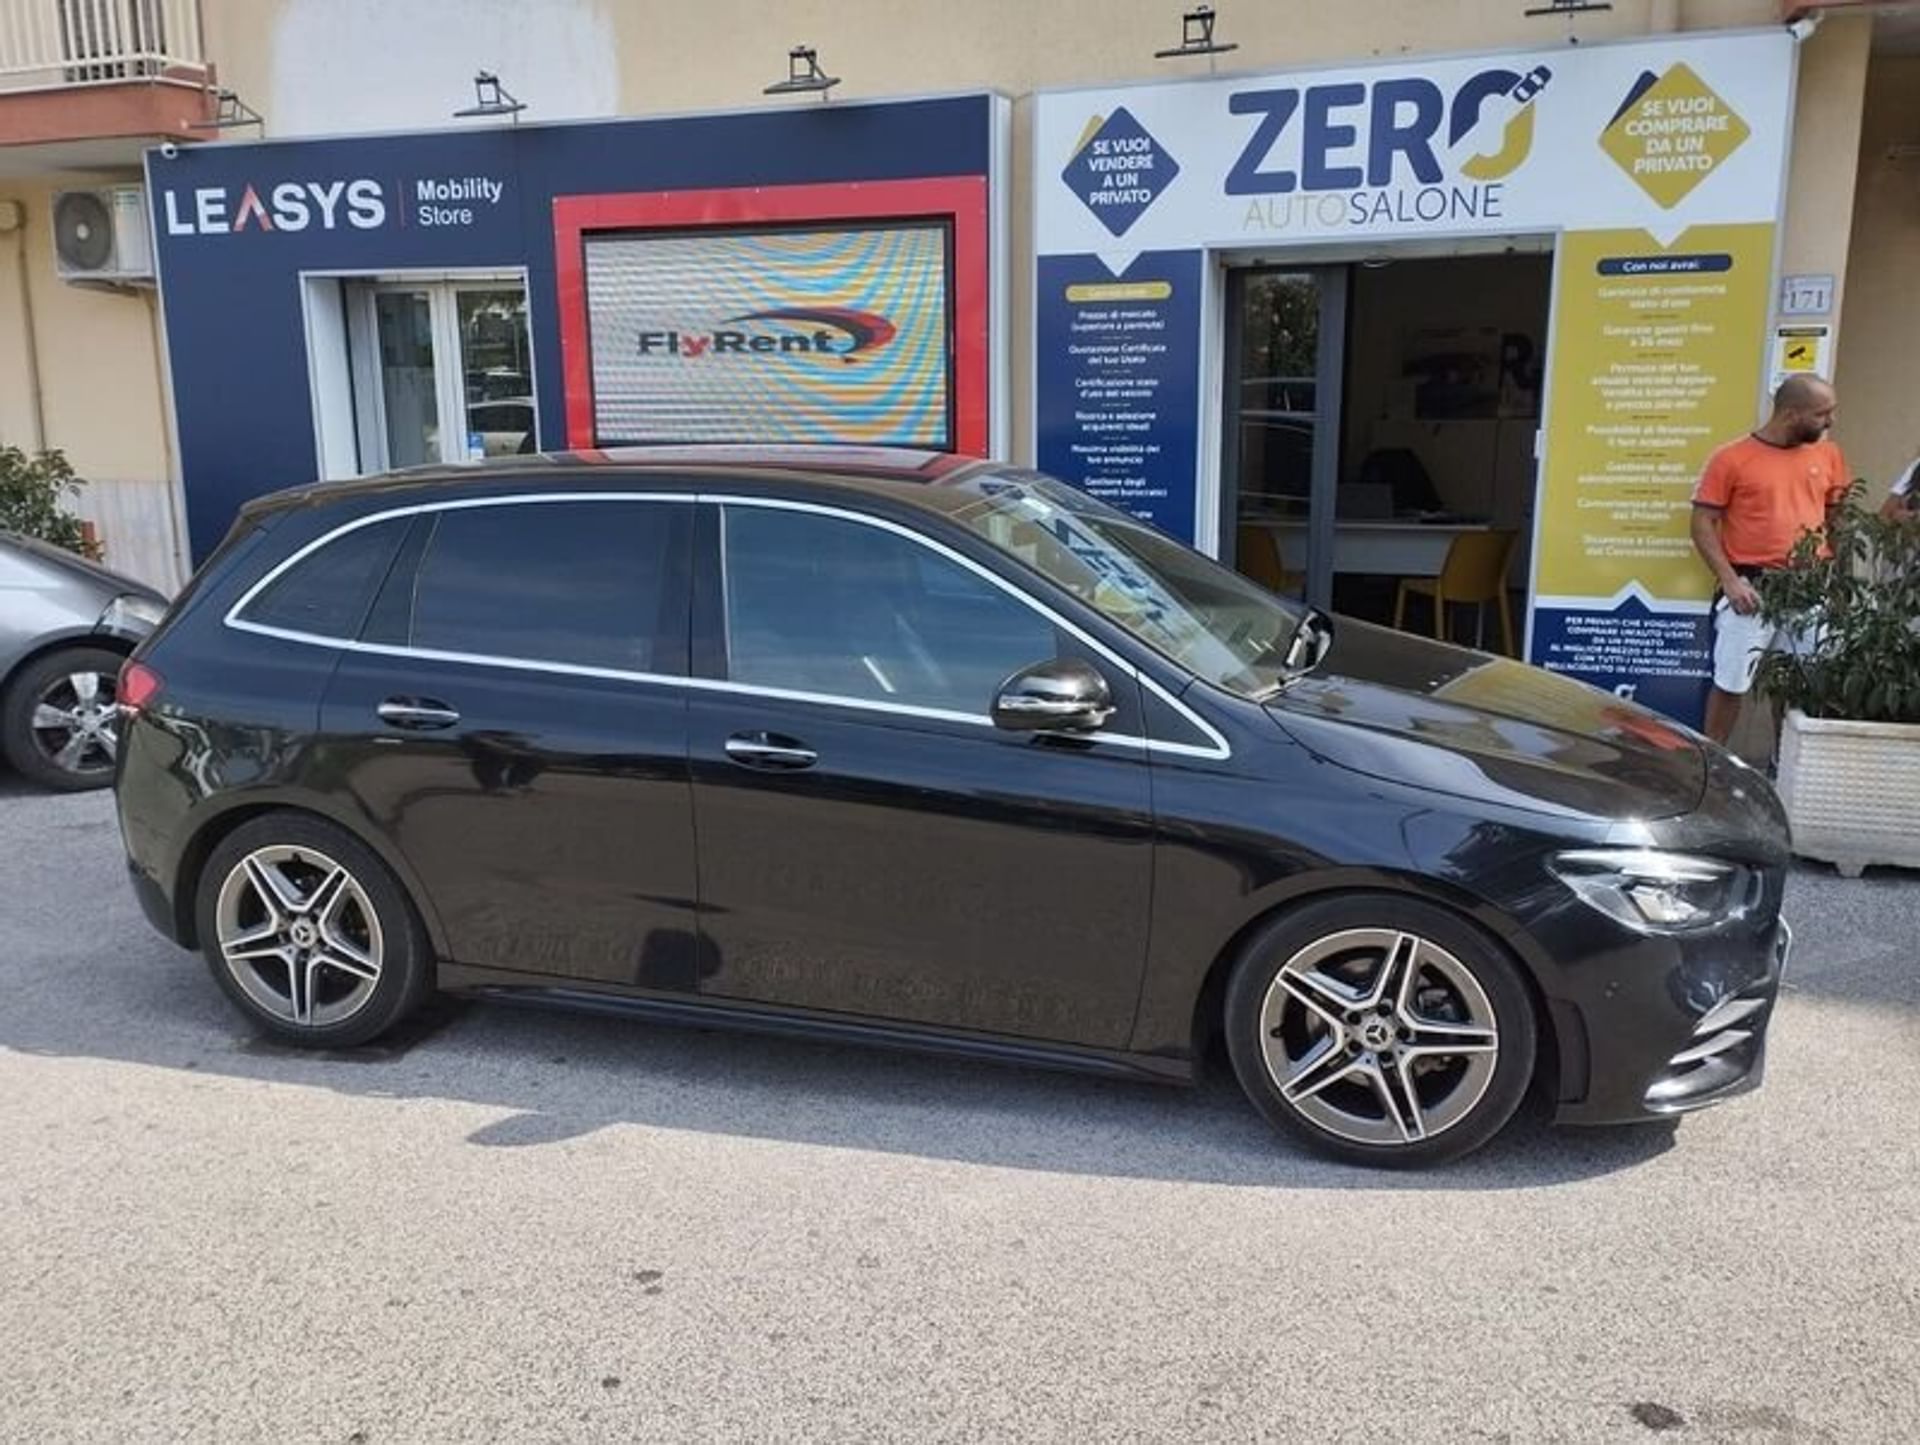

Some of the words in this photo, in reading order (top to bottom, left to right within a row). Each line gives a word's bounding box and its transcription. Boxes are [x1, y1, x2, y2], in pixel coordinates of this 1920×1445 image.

[1642, 101, 1663, 117] SE
[1667, 97, 1715, 113] VUOI
[1224, 68, 1540, 195] ZERO
[1624, 115, 1729, 136] COMPRARE
[1093, 140, 1110, 155] SE
[1111, 137, 1151, 153] VUOI
[1646, 138, 1671, 154] DA
[1675, 135, 1704, 152] UN
[1088, 154, 1154, 171] VENDERE
[1633, 155, 1713, 174] PRIVATO
[1103, 173, 1113, 188] A
[1115, 172, 1138, 187] UN
[416, 178, 503, 203] Mobility
[1089, 188, 1151, 205] PRIVATO
[164, 179, 386, 235] LEASYS
[419, 207, 473, 226] Store
[1622, 261, 1647, 273] Con
[1649, 260, 1668, 271] noi
[1790, 290, 1824, 309] 171
[637, 329, 834, 358] FlyRent
[1564, 616, 1583, 626] PER
[1622, 618, 1641, 628] CHE
[1643, 619, 1697, 630] VOGLIONO
[1567, 626, 1618, 637] COMPRARE
[1608, 636, 1622, 646] UN
[1624, 637, 1665, 648] PRIVATO
